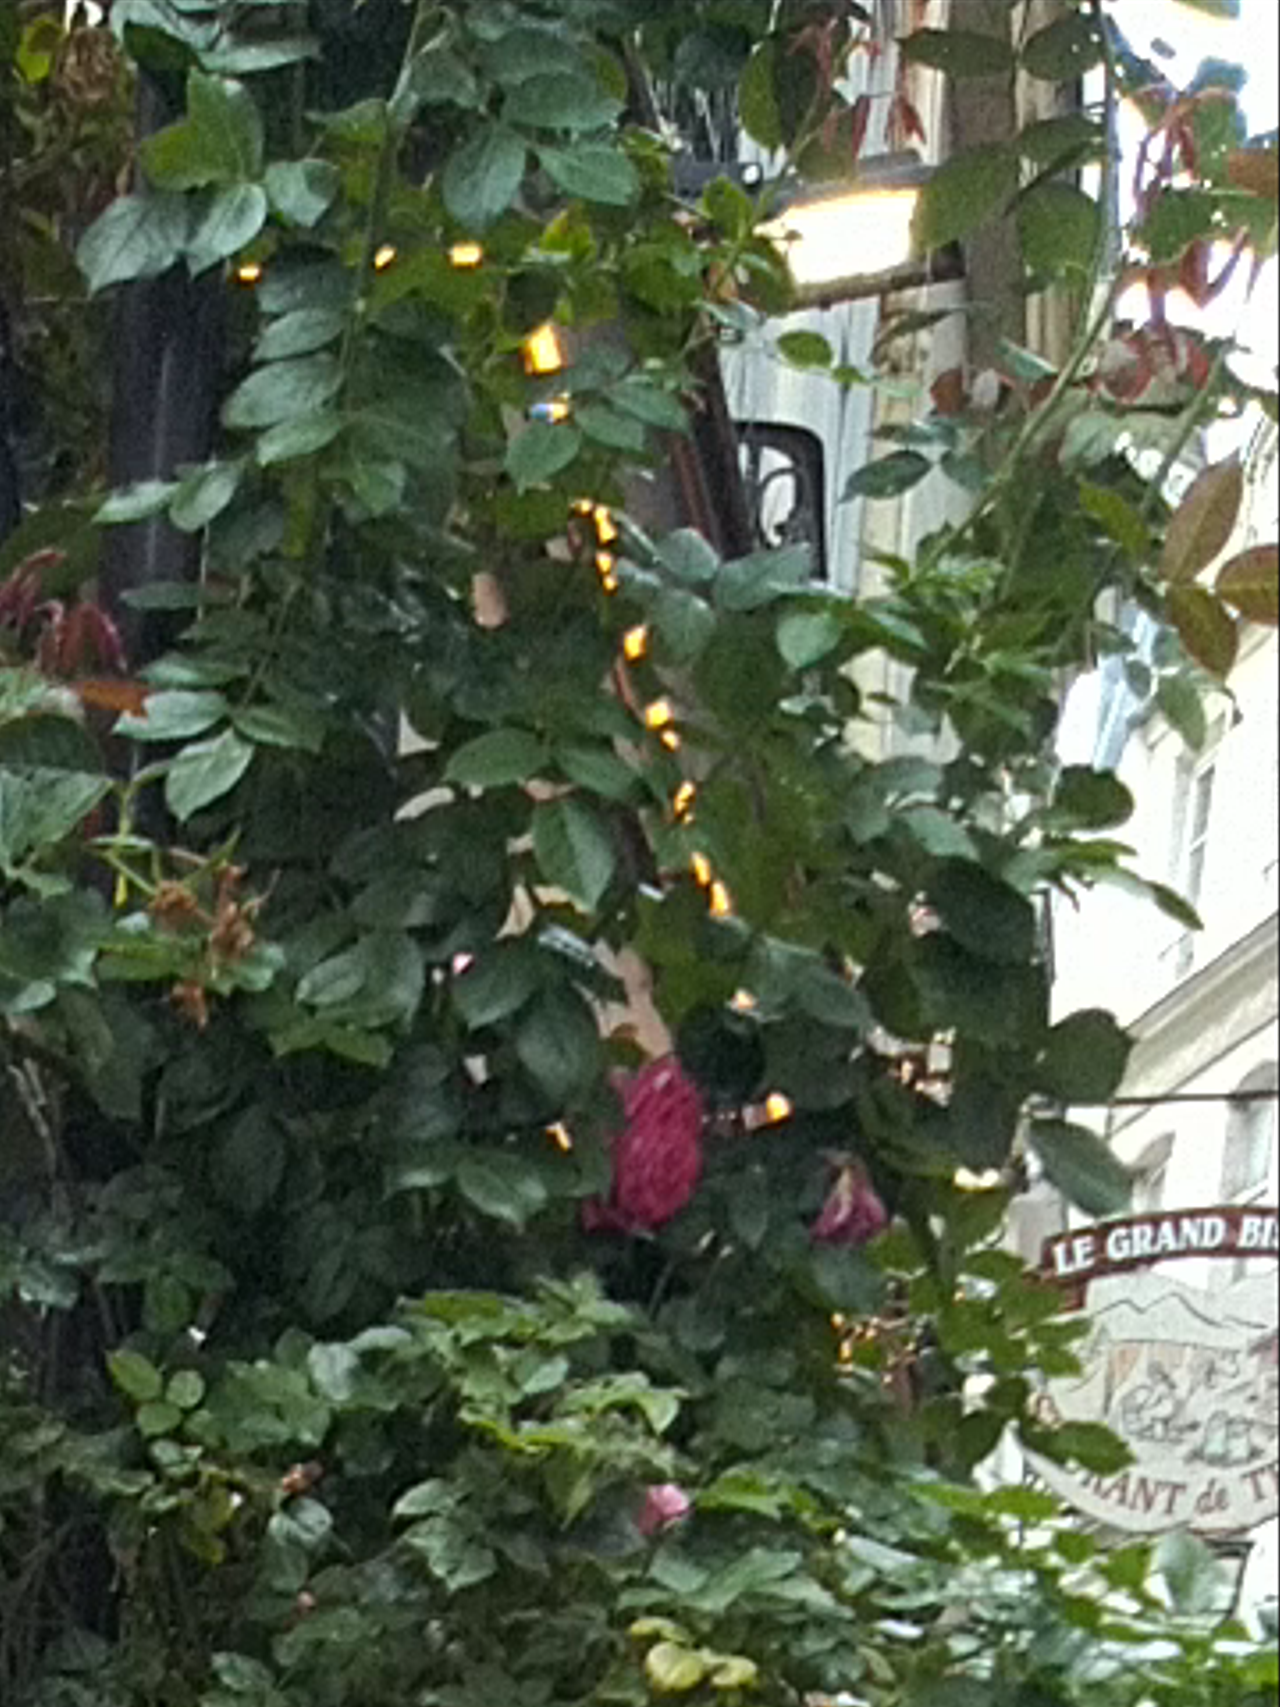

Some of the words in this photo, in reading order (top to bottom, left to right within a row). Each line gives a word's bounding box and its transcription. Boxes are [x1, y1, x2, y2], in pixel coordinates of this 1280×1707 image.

[1053, 1235, 1096, 1277] LE
[1106, 1216, 1227, 1262] GRAND
[1196, 1478, 1229, 1515] de
[1241, 1462, 1279, 1501] T
